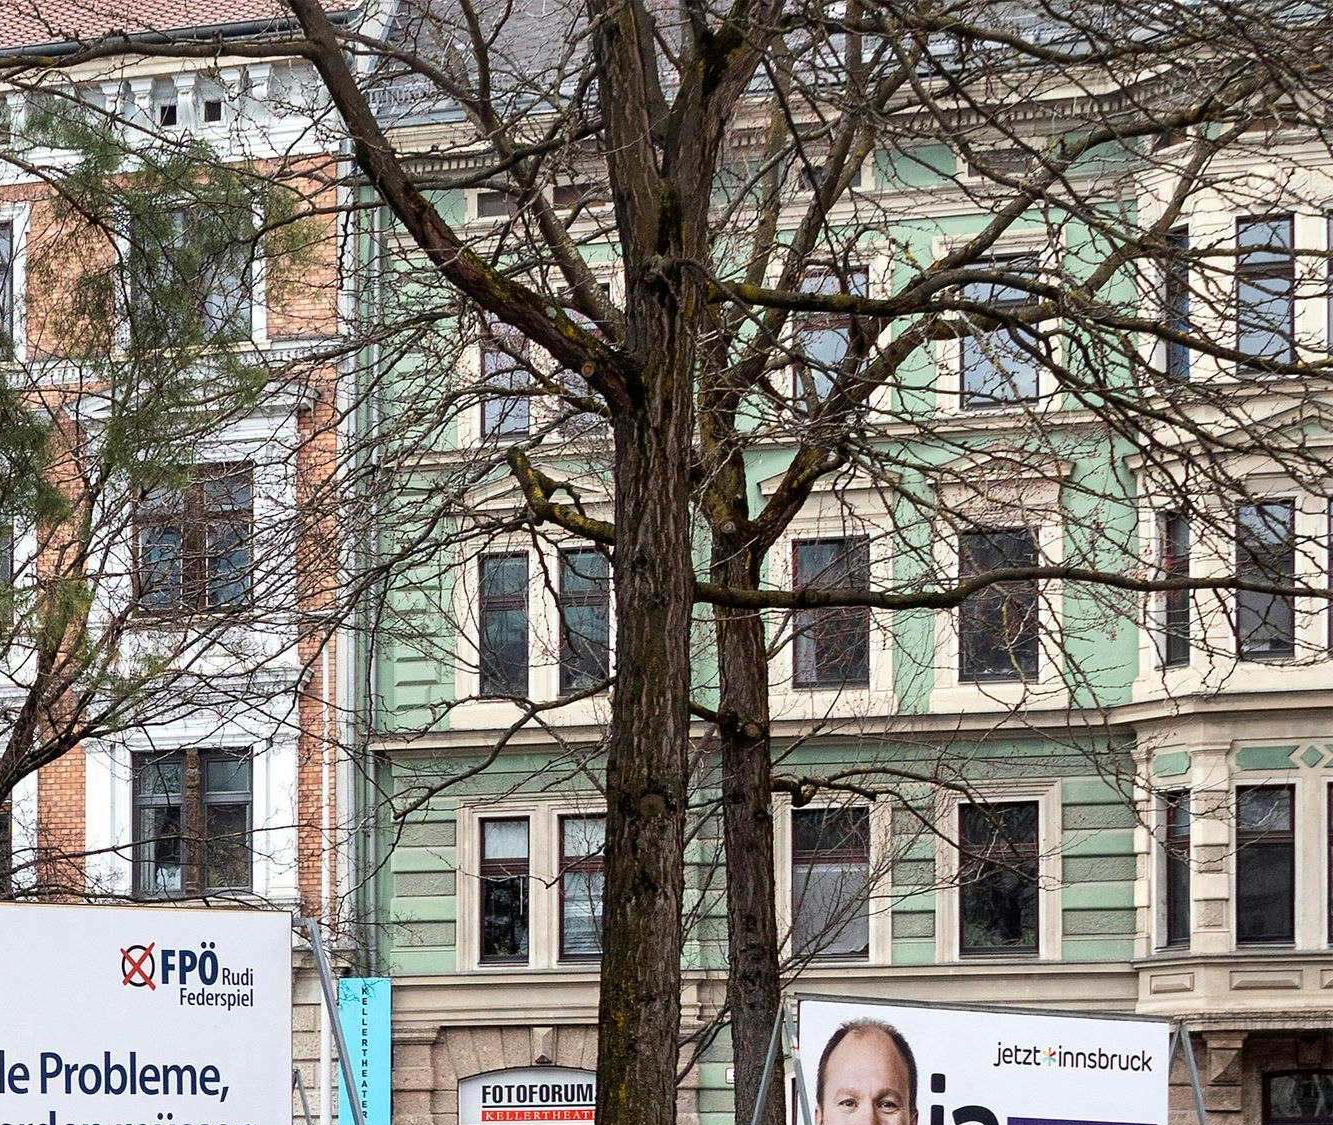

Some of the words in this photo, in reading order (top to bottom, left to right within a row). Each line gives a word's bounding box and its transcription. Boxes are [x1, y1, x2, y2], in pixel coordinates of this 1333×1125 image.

[161, 941, 219, 987] FPÖ
[222, 967, 254, 986] Rudi
[179, 987, 254, 1011] Federspiel
[361, 986, 369, 1119] KELLERTHEATER
[993, 1042, 1041, 1067] jetzt
[1058, 1045, 1152, 1072] innsbruck
[40, 1051, 230, 1103] Probleme,
[482, 1084, 593, 1103] FOTOFORUM
